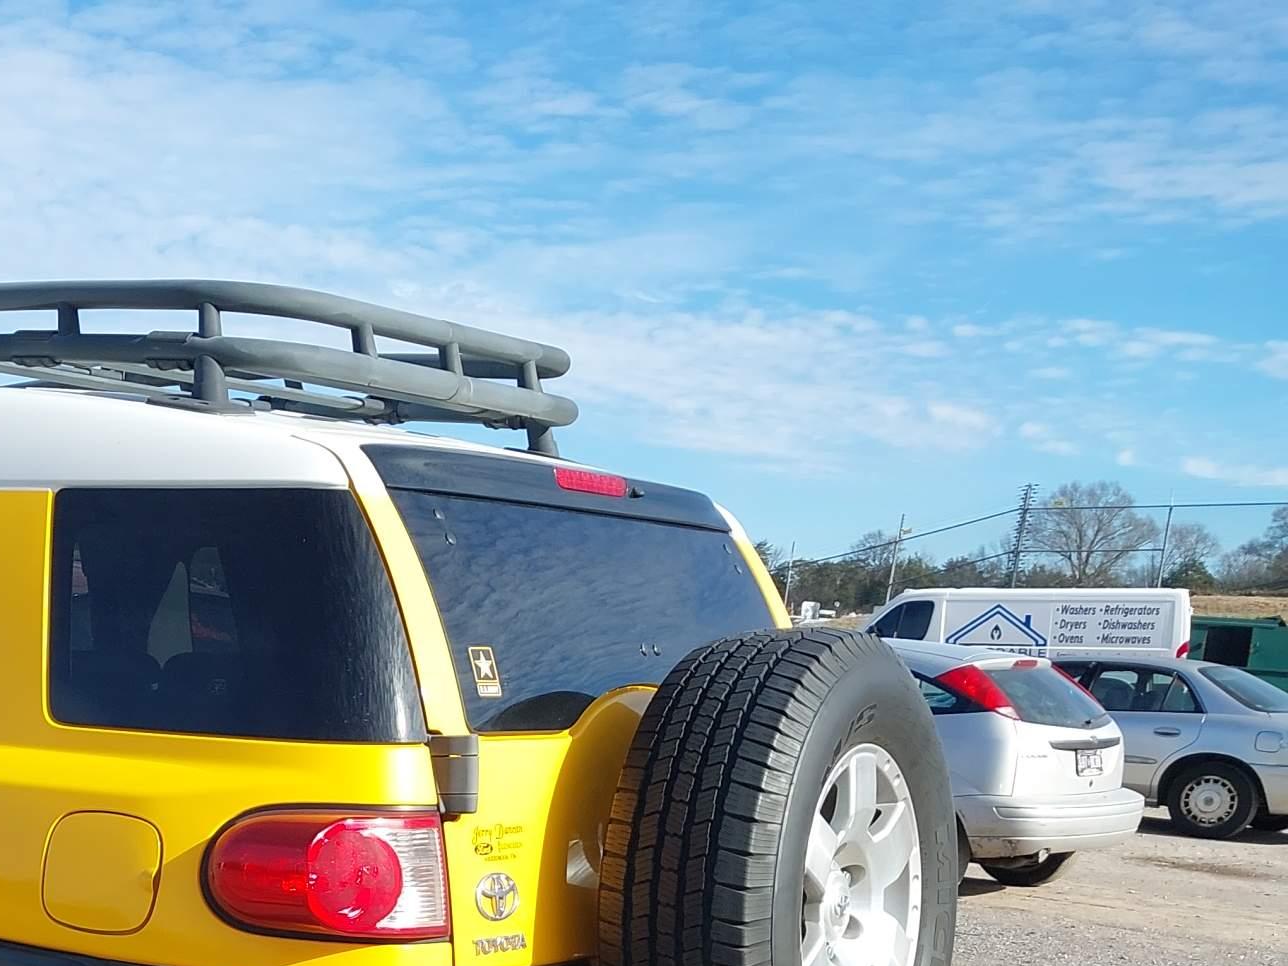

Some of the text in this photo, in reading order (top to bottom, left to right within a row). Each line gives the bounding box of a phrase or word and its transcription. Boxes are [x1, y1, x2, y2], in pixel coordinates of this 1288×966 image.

[1060, 604, 1096, 615] Washers
[1103, 604, 1160, 617] Refrigerators
[1059, 619, 1087, 631] Dryers
[1102, 619, 1155, 630] Dishwashers
[1058, 633, 1084, 643] Ovens
[1101, 633, 1151, 644] Microwaves
[472, 933, 527, 956] TOYOTA
